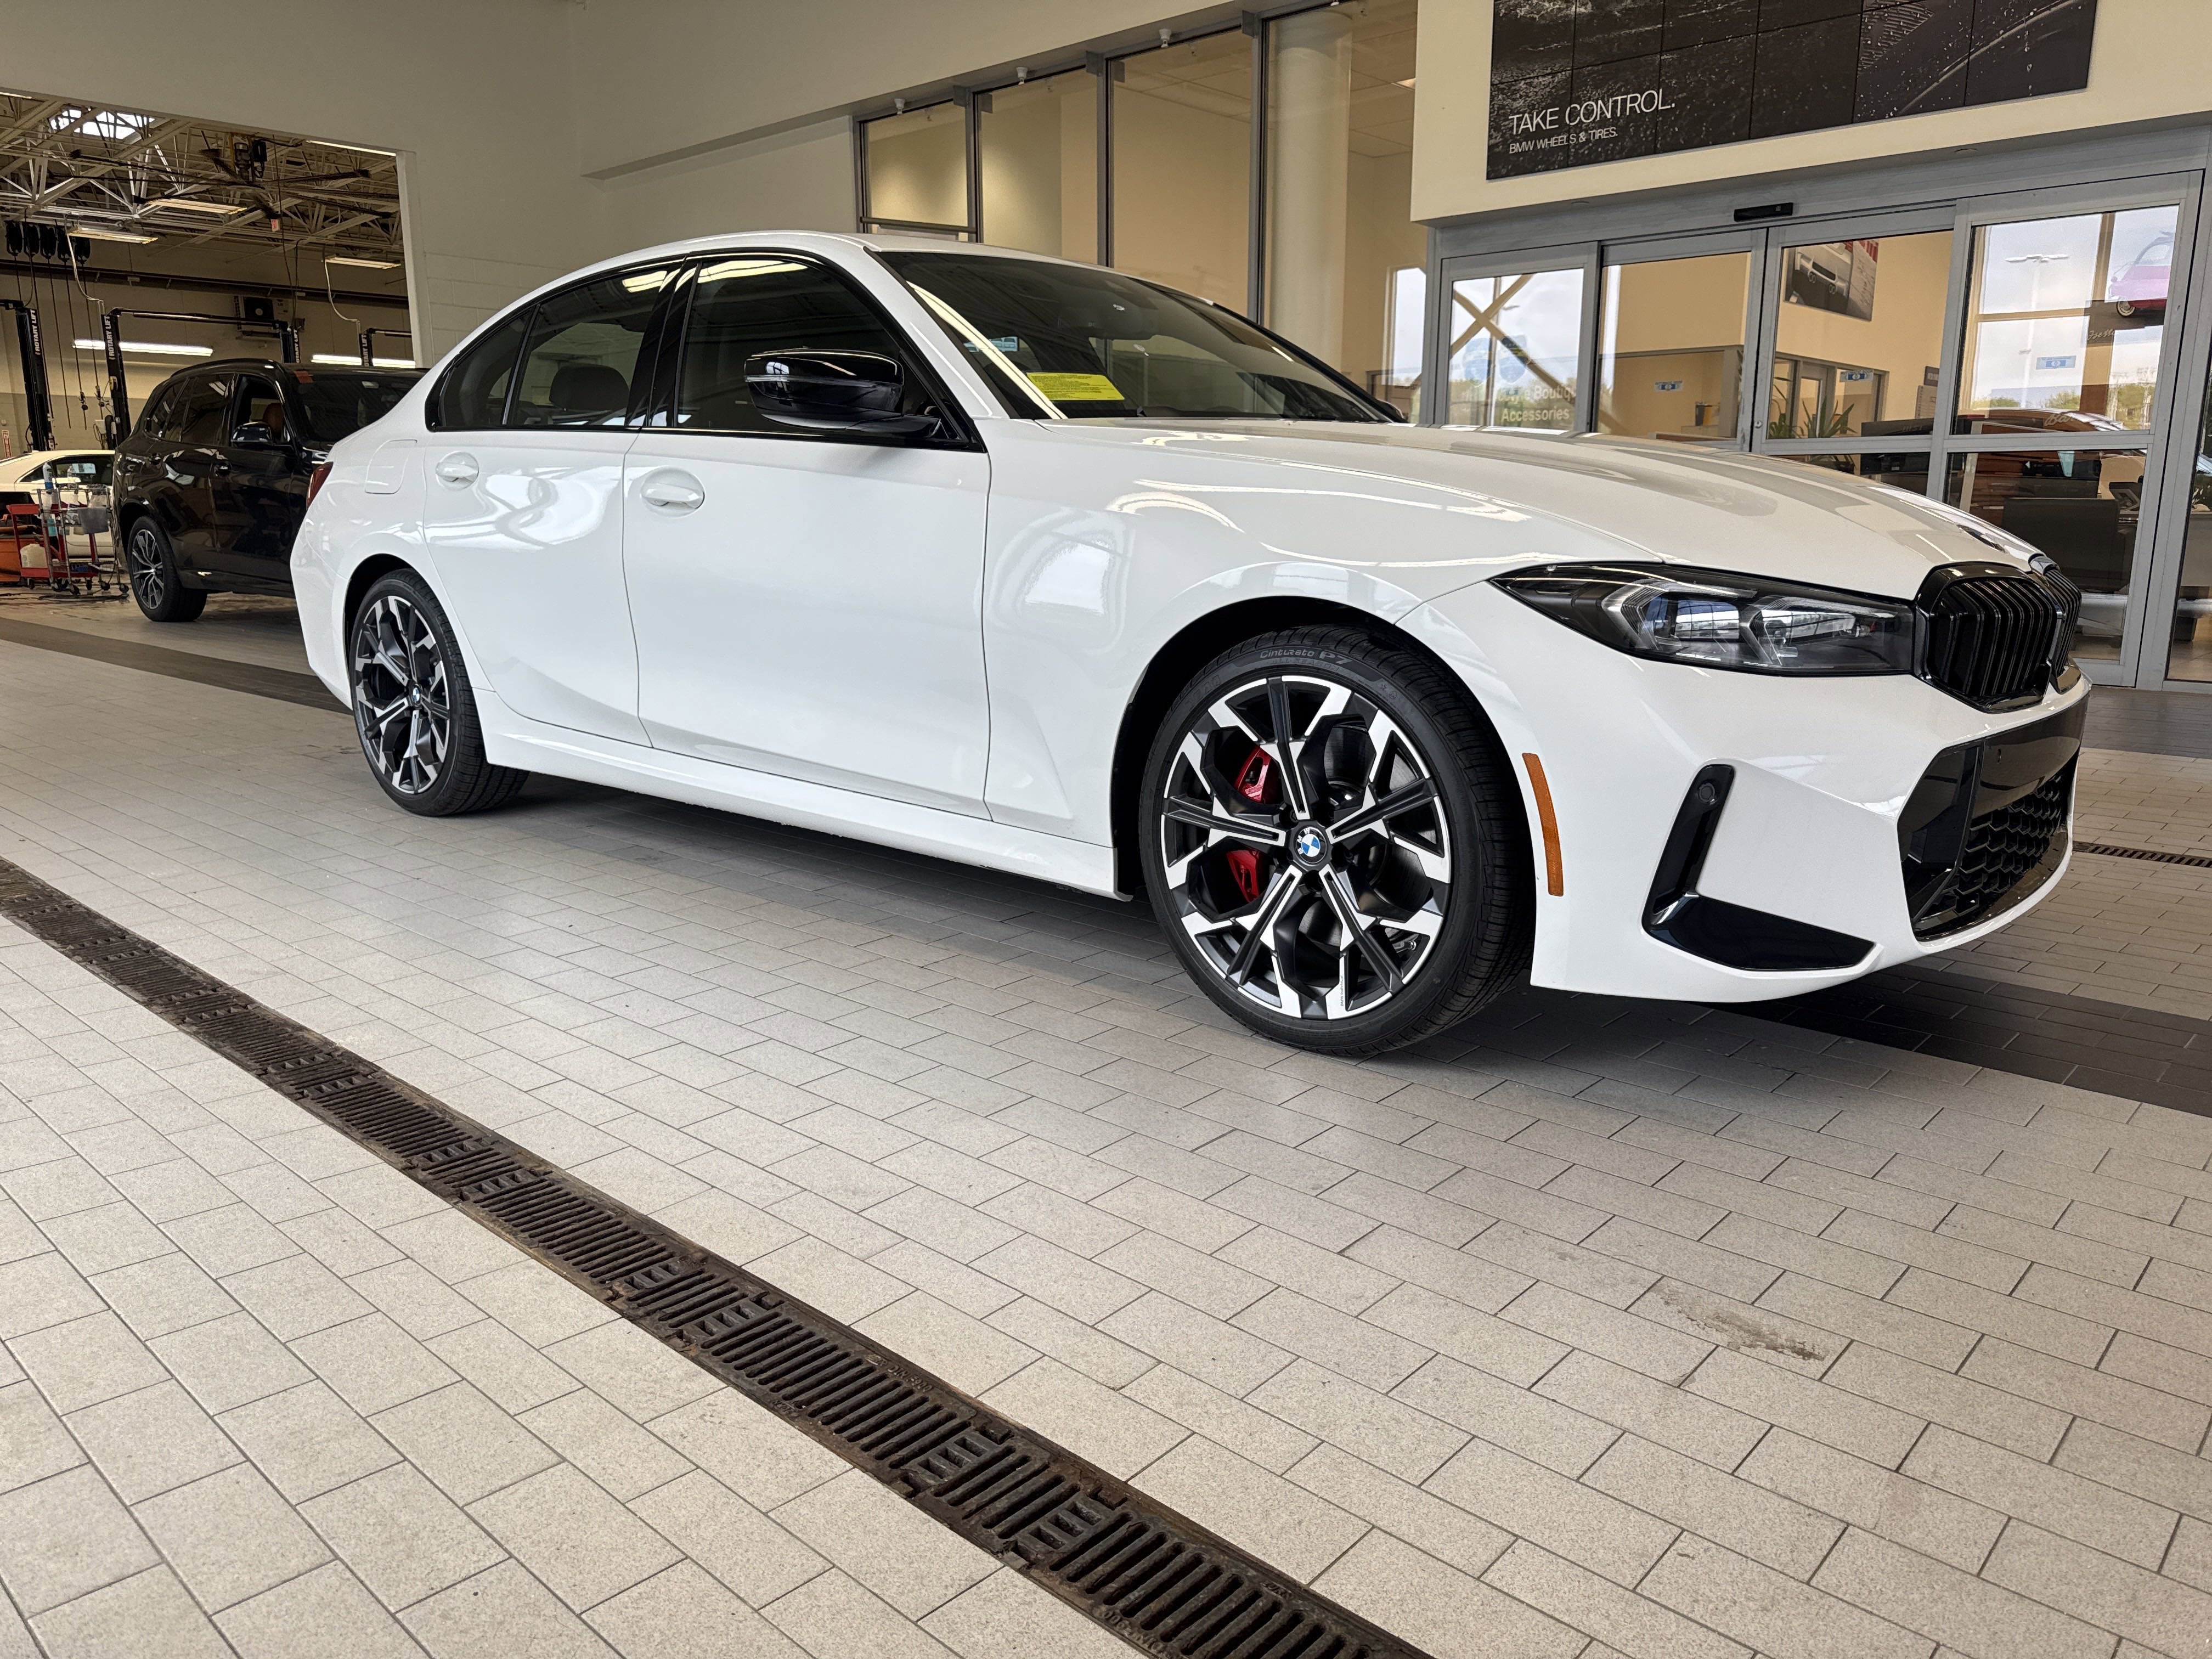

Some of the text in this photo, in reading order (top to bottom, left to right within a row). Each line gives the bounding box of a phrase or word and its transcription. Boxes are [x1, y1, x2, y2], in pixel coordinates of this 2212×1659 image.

[1509, 88, 1675, 135] TAKE CONTROL.
[1509, 127, 1618, 154] BMW WHEELS & TIRES.
[106, 330, 115, 357] ROTARY
[1534, 385, 1576, 401] Boutiqu
[1502, 405, 1570, 422] Accessories
[1260, 648, 1352, 664] Cinturato P7
